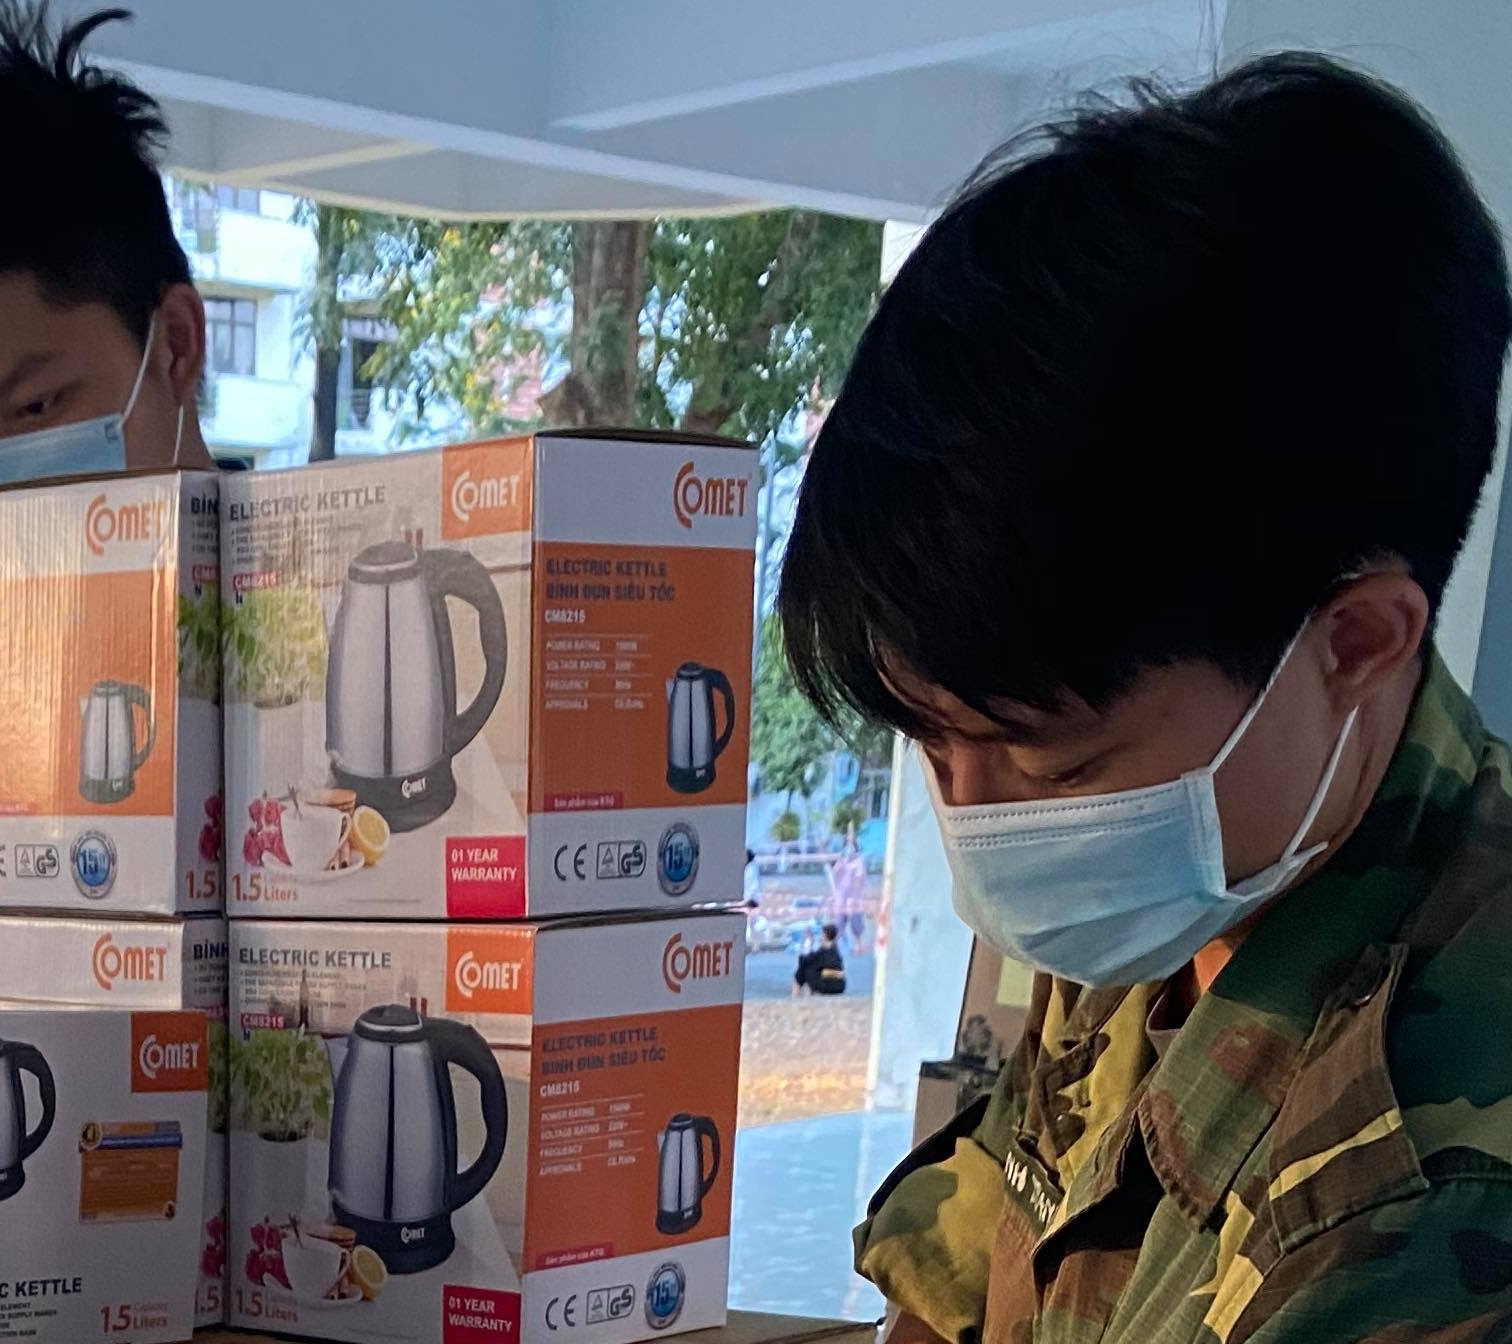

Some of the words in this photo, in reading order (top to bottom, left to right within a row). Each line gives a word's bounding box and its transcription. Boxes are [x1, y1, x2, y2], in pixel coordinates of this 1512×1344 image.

[230, 495, 310, 520] ELECTRIC
[318, 486, 386, 512] KETTLE
[451, 470, 520, 522] COMET
[674, 462, 748, 529] COMET
[232, 872, 262, 901] 1.5
[264, 884, 298, 901] Liters
[92, 932, 168, 991] COMET
[240, 948, 318, 966] ELECTRIC
[325, 950, 391, 969] KETTLE
[455, 951, 521, 998] COMET
[661, 932, 734, 994] COMET
[139, 1033, 201, 1079] COMET
[15, 1277, 82, 1298] KETTLE
[449, 1296, 465, 1311] 01
[468, 1298, 495, 1313] YEAR
[101, 1304, 131, 1333] 1.5
[133, 1315, 167, 1329] Liters
[449, 1313, 512, 1333] WARRANTY
